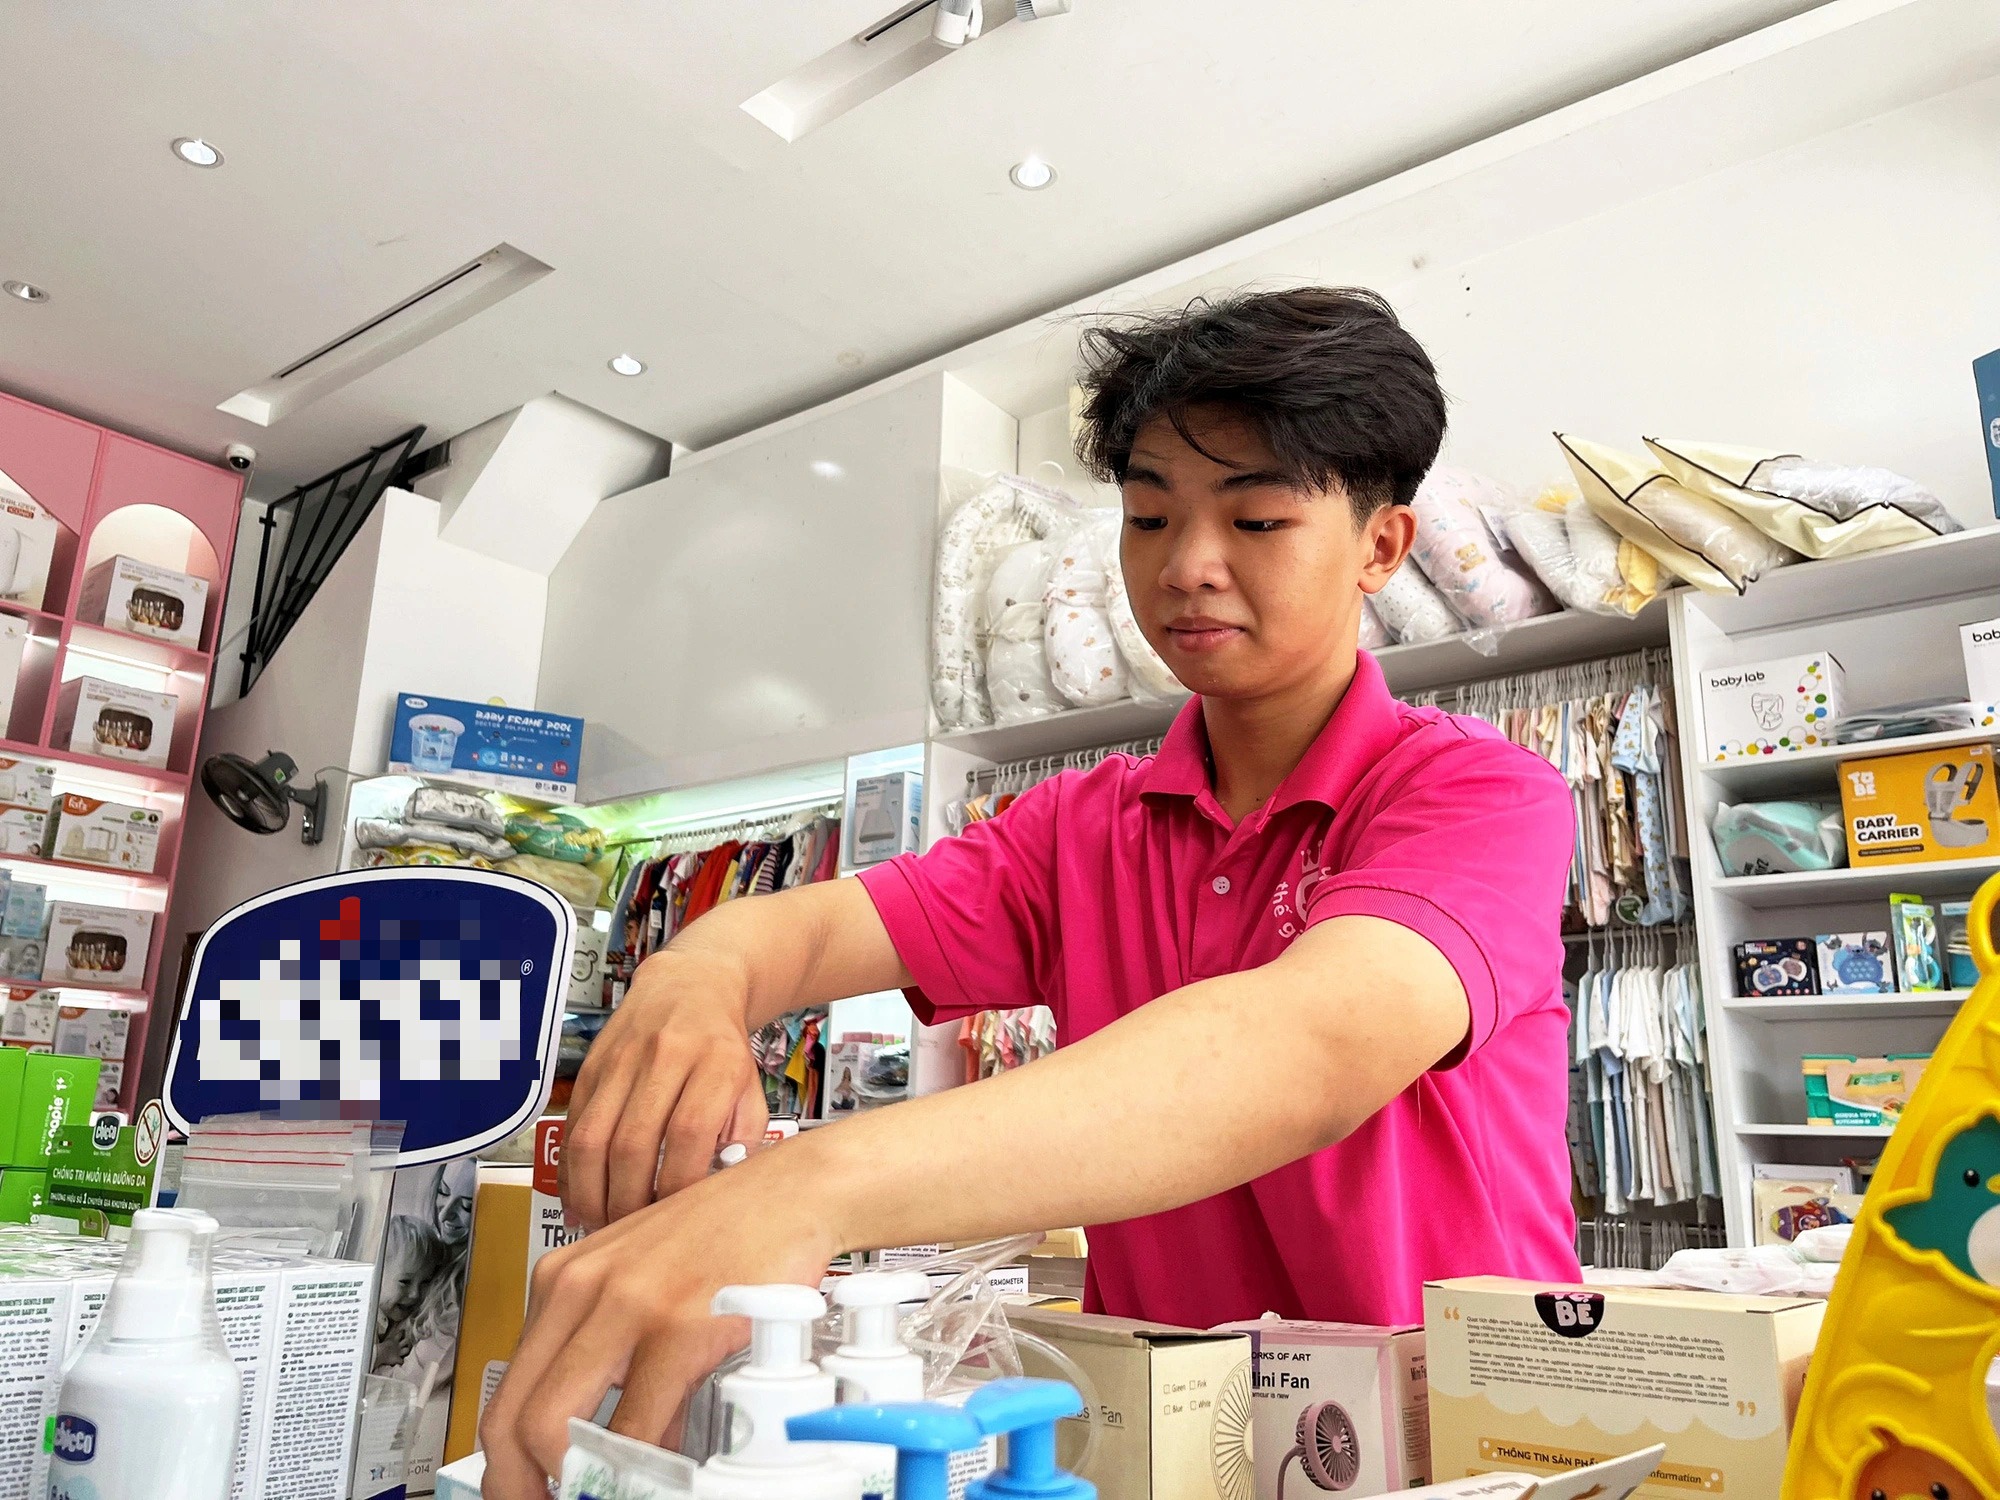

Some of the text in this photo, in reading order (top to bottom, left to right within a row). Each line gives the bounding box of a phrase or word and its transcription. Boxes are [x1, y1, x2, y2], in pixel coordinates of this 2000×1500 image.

[1711, 676, 1742, 687] baby
[1745, 671, 1765, 682] lab
[475, 710, 572, 733] BABY FRAME POOL
[1856, 816, 1894, 829] BABY
[1858, 827, 1919, 841] CARRIER
[136, 1176, 146, 1187] DA
[542, 1208, 563, 1219] BABY
[1277, 1352, 1290, 1361] OF
[1292, 1353, 1311, 1362] ART
[1281, 1372, 1310, 1389] Fan
[1497, 1447, 1531, 1460] THÔNG
[1533, 1452, 1550, 1462] TIN
